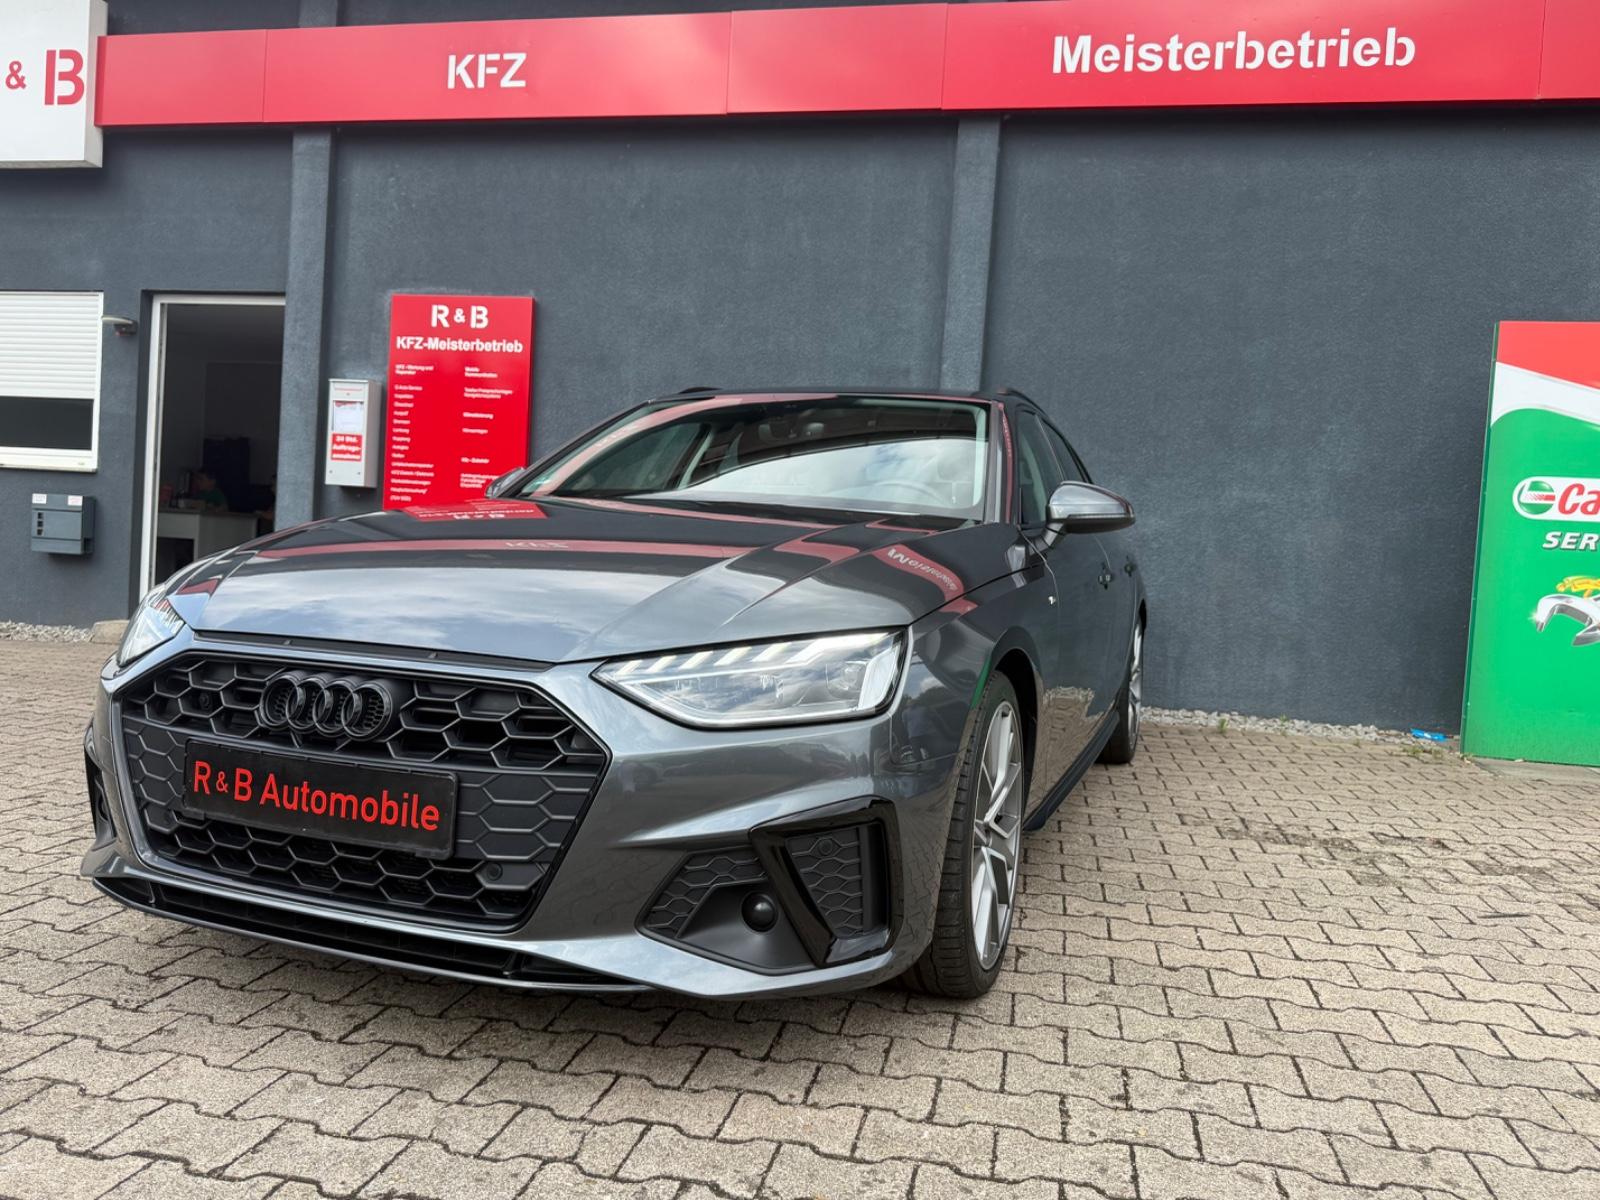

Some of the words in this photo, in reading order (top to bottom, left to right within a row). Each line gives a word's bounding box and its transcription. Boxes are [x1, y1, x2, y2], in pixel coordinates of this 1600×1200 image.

[447, 52, 528, 90] KFZ
[1052, 27, 1416, 74] Meisterbetrieb
[5, 61, 26, 90] &
[44, 49, 85, 106] B
[431, 304, 450, 328] R
[453, 307, 466, 324] &
[470, 305, 489, 329] B
[396, 336, 523, 353] KFZ-Meisterbetrieb
[1557, 483, 1600, 516] Ca
[1542, 531, 1599, 550] SER
[193, 760, 211, 794] R
[216, 771, 228, 793] &
[234, 768, 253, 802] B
[260, 773, 440, 831] Automobile
